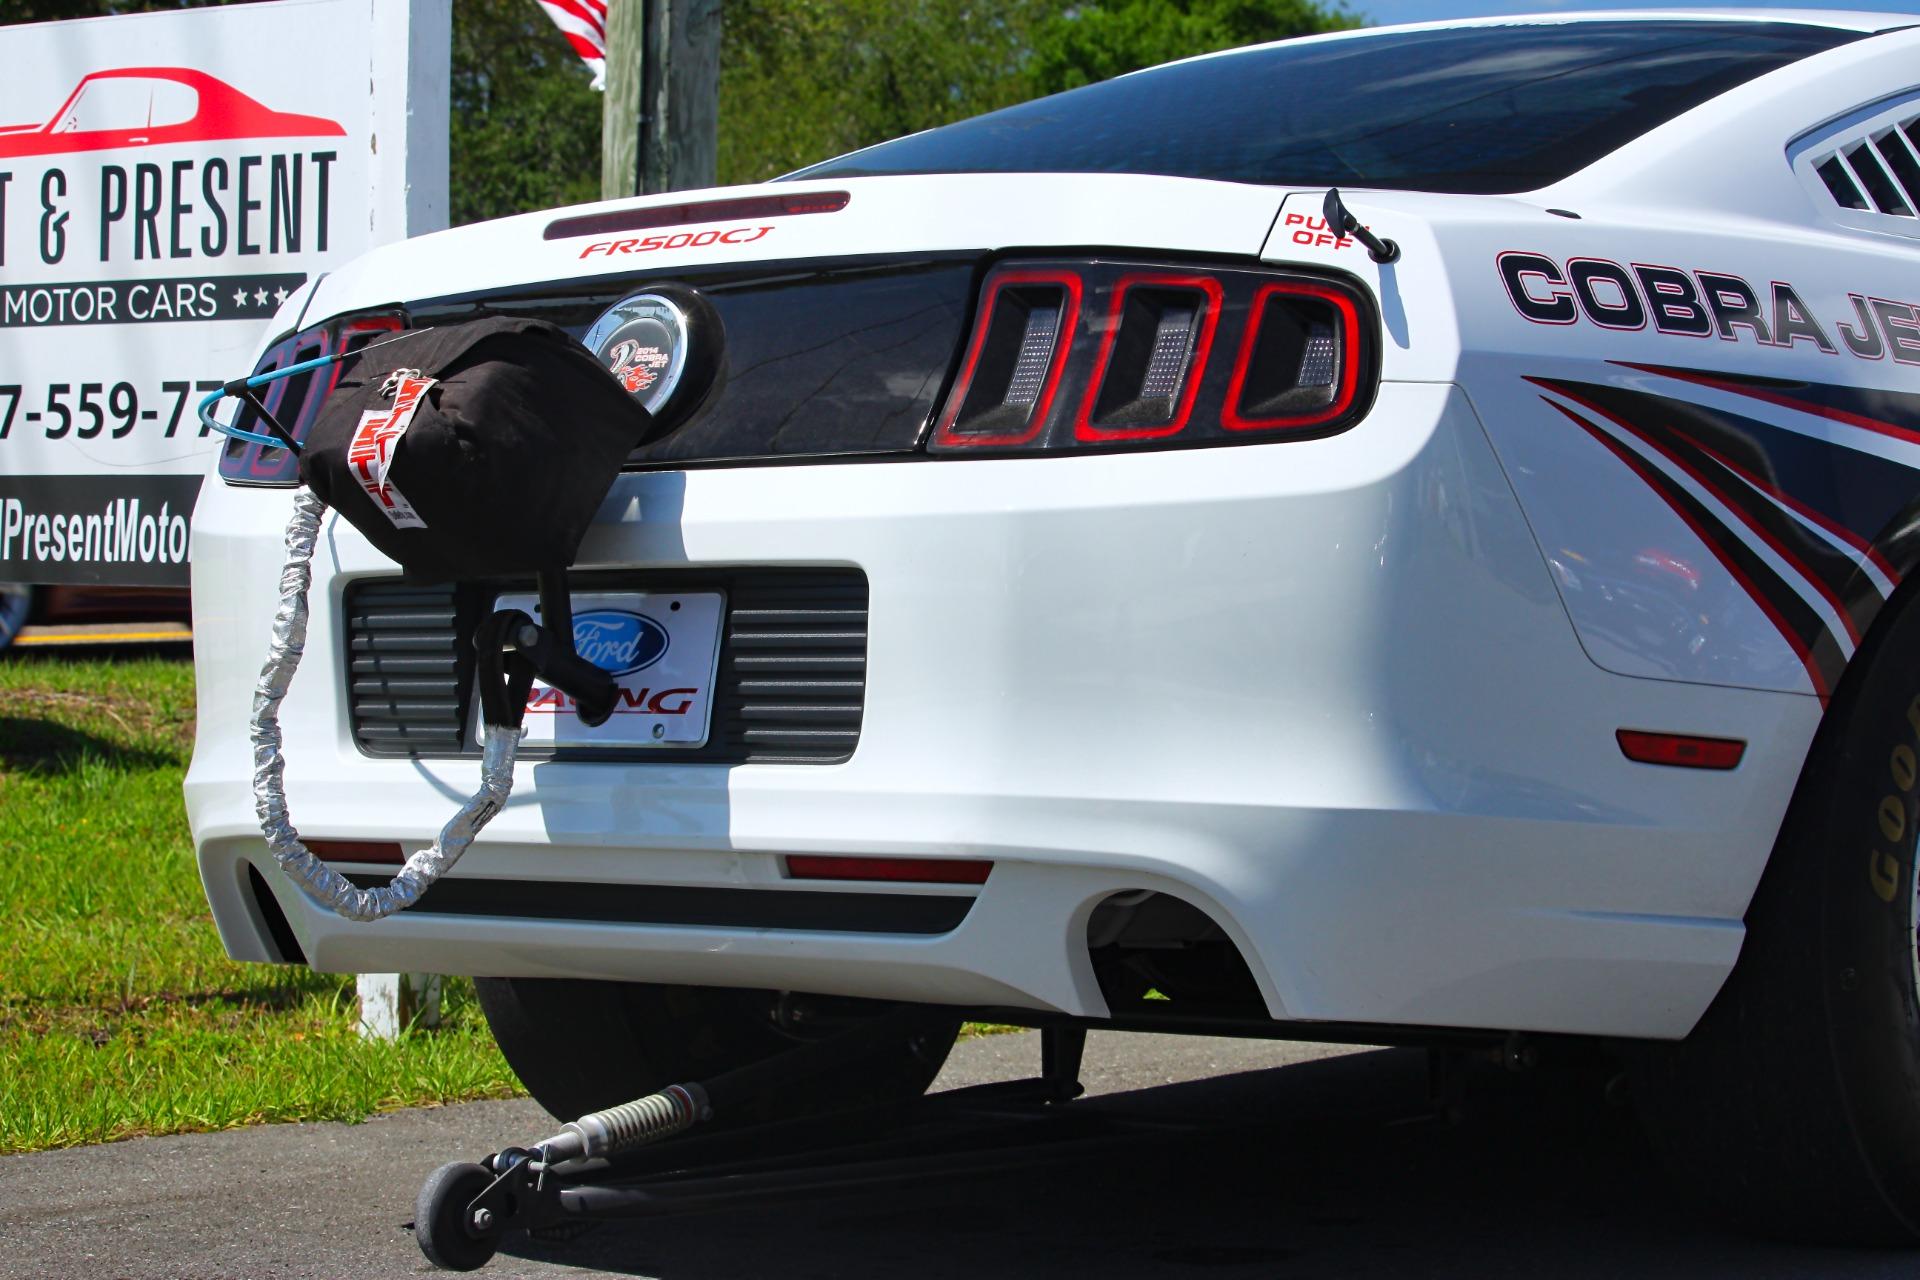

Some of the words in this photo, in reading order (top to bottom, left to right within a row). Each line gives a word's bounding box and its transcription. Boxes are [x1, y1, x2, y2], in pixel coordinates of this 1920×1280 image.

[40, 168, 70, 265] &
[100, 151, 337, 262] PRESENT
[578, 226, 776, 259] FR500CJ
[1292, 230, 1354, 250] OFF
[4, 286, 117, 324] MOTOR
[128, 282, 217, 320] CARS
[1496, 250, 1840, 355] COBRA
[1836, 292, 1920, 367] JE
[634, 353, 669, 362] COBRA
[572, 620, 645, 663] Ford
[1870, 693, 1920, 902] GOO
